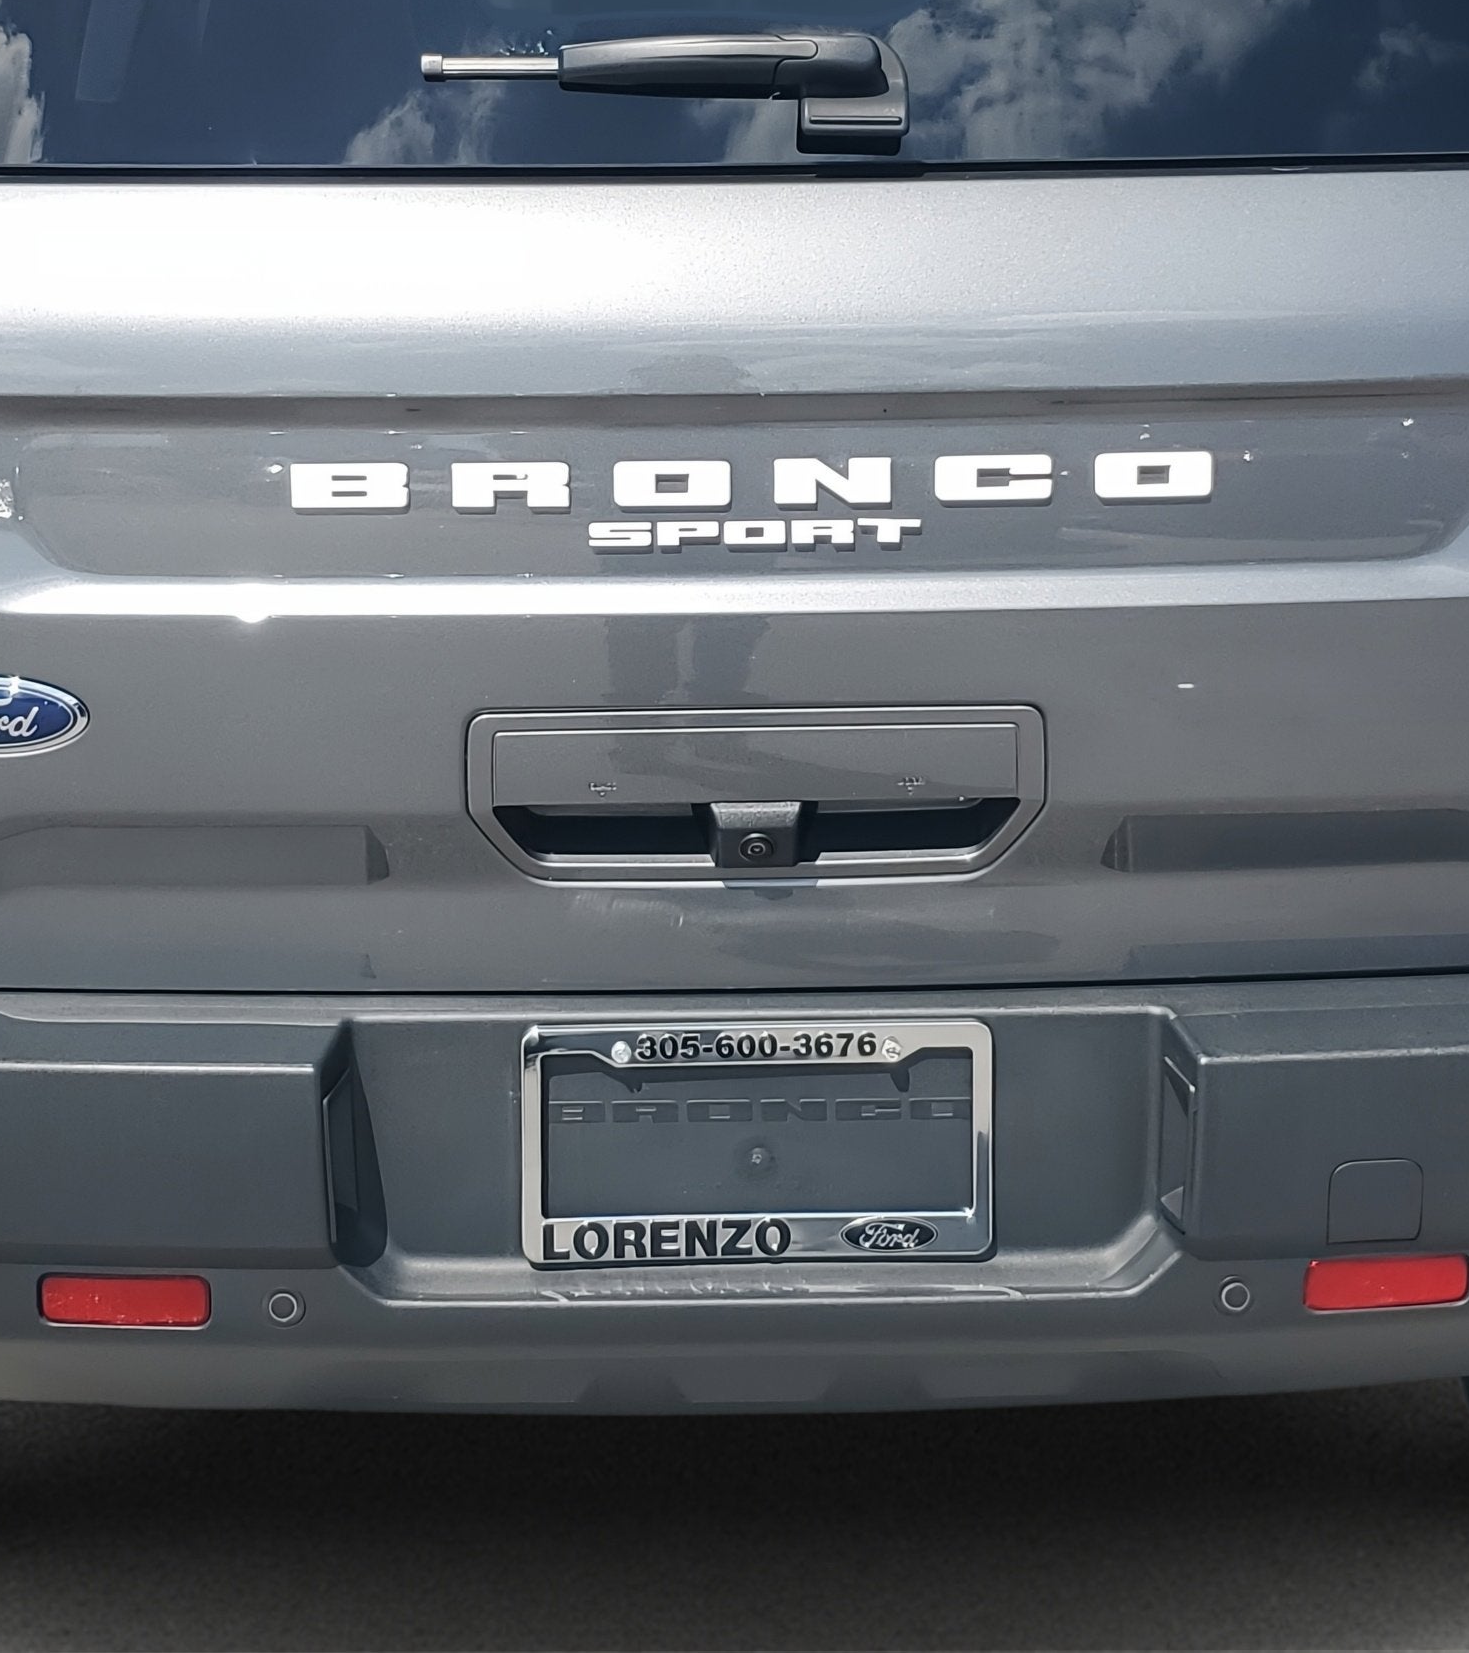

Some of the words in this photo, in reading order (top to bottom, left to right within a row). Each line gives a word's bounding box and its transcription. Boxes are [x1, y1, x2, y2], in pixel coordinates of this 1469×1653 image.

[290, 450, 1215, 514] BRONCO
[587, 518, 922, 554] SPORT
[635, 1031, 878, 1061] 305-600-3676
[541, 1219, 792, 1261] LORENZO
[858, 1222, 920, 1251] Ford
